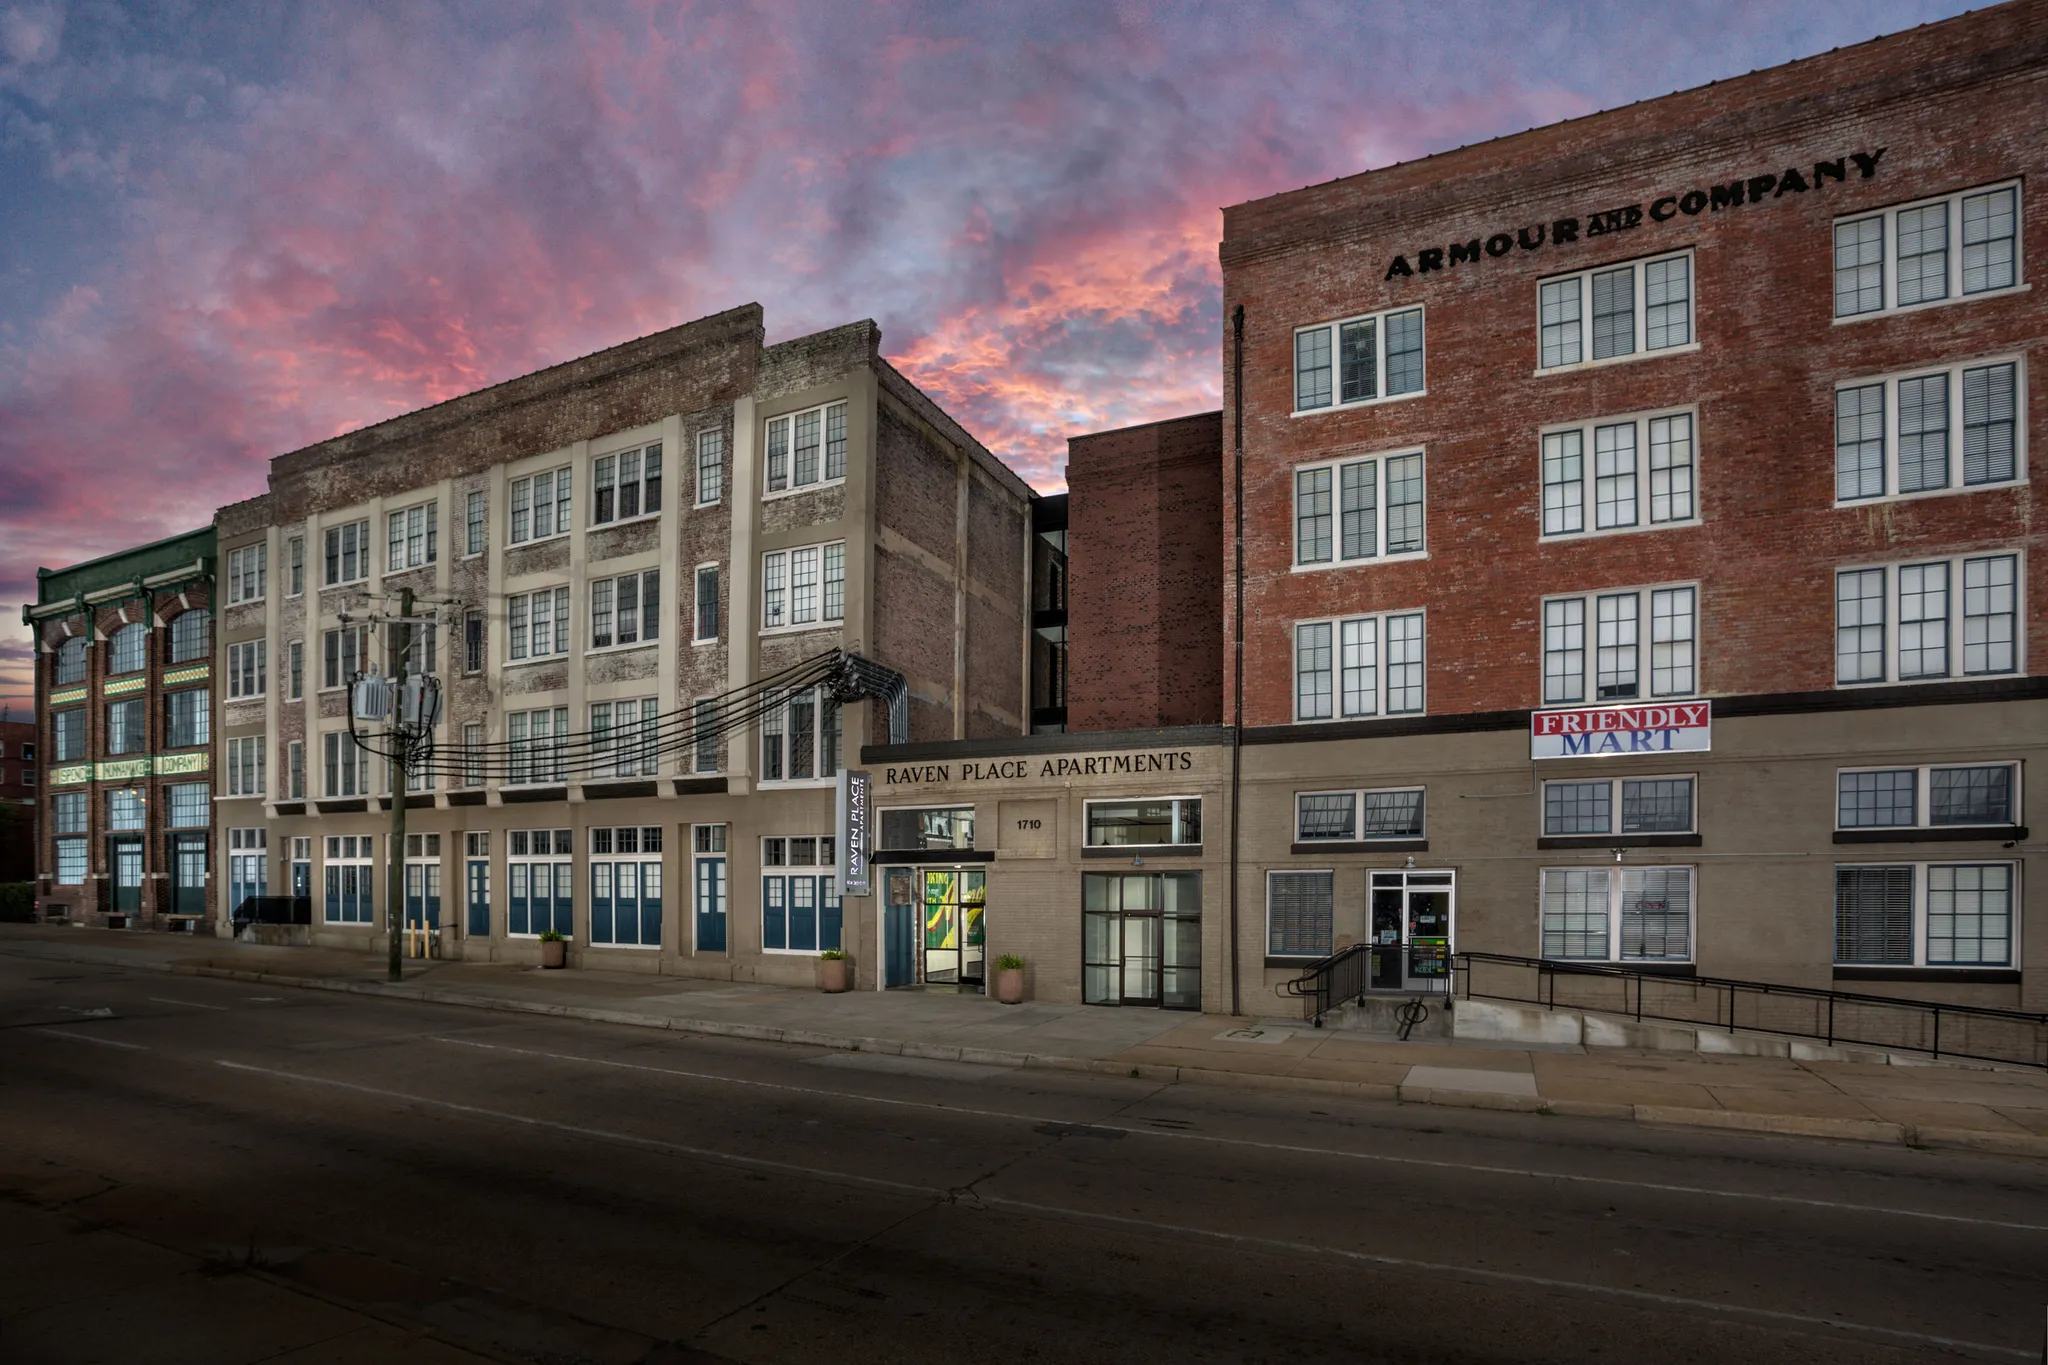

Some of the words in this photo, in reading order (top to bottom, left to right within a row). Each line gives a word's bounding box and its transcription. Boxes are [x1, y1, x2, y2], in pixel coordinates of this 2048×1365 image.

[1384, 218, 1580, 281] ARMOUR
[1587, 204, 1641, 237] AND
[1649, 147, 1890, 222] COMPANY
[1540, 705, 1707, 735] FRIENDLY
[1560, 728, 1680, 756] MART
[164, 755, 198, 772] COMPANY
[886, 765, 949, 784] RAVEN
[962, 761, 1027, 781] PLACE
[1040, 751, 1192, 777] APARTMENTS
[851, 776, 860, 822] PLACE
[1017, 819, 1041, 830] 1710
[850, 828, 859, 875] RAVEN
